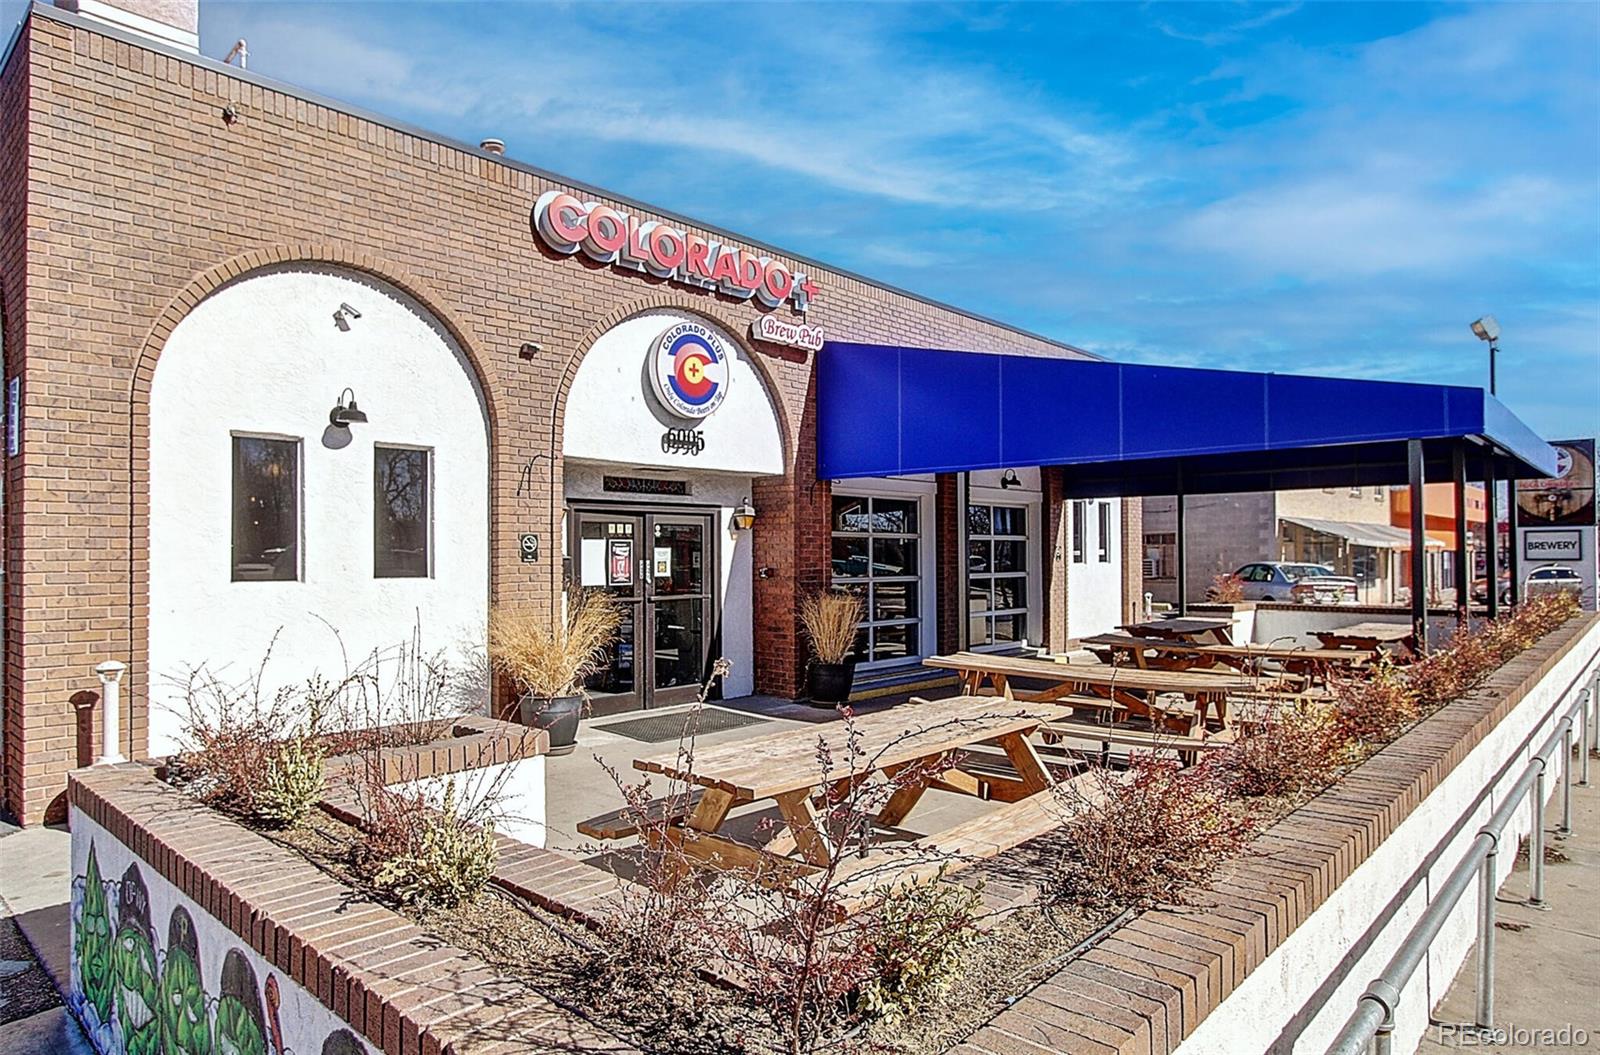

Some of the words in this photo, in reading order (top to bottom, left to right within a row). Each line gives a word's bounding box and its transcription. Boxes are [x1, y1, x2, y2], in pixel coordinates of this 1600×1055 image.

[538, 191, 793, 304] COLORADO
[662, 324, 706, 350] COLORADO
[707, 334, 724, 361] PLUS
[764, 318, 797, 340] Brew
[798, 328, 822, 347] Pub
[1527, 541, 1578, 551] BREWERY
